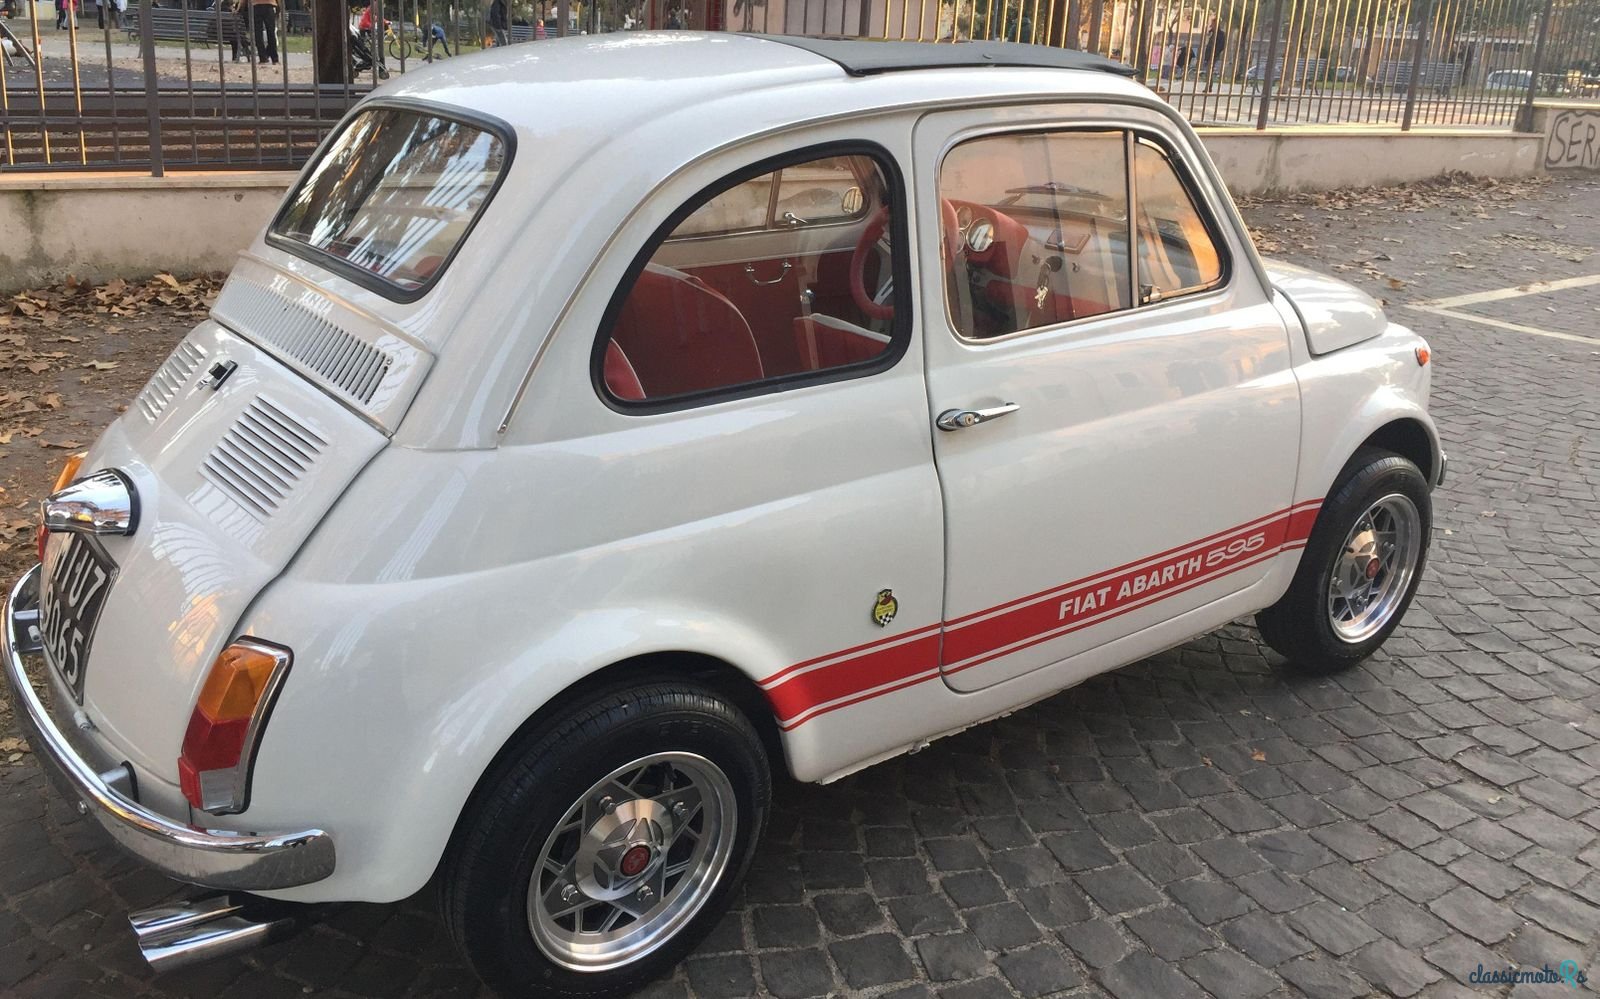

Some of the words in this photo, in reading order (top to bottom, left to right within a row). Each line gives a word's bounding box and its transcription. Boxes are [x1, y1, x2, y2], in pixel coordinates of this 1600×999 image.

[1058, 587, 1112, 620] FIAT
[1116, 555, 1203, 600] ABARTH
[1205, 532, 1265, 567] 595
